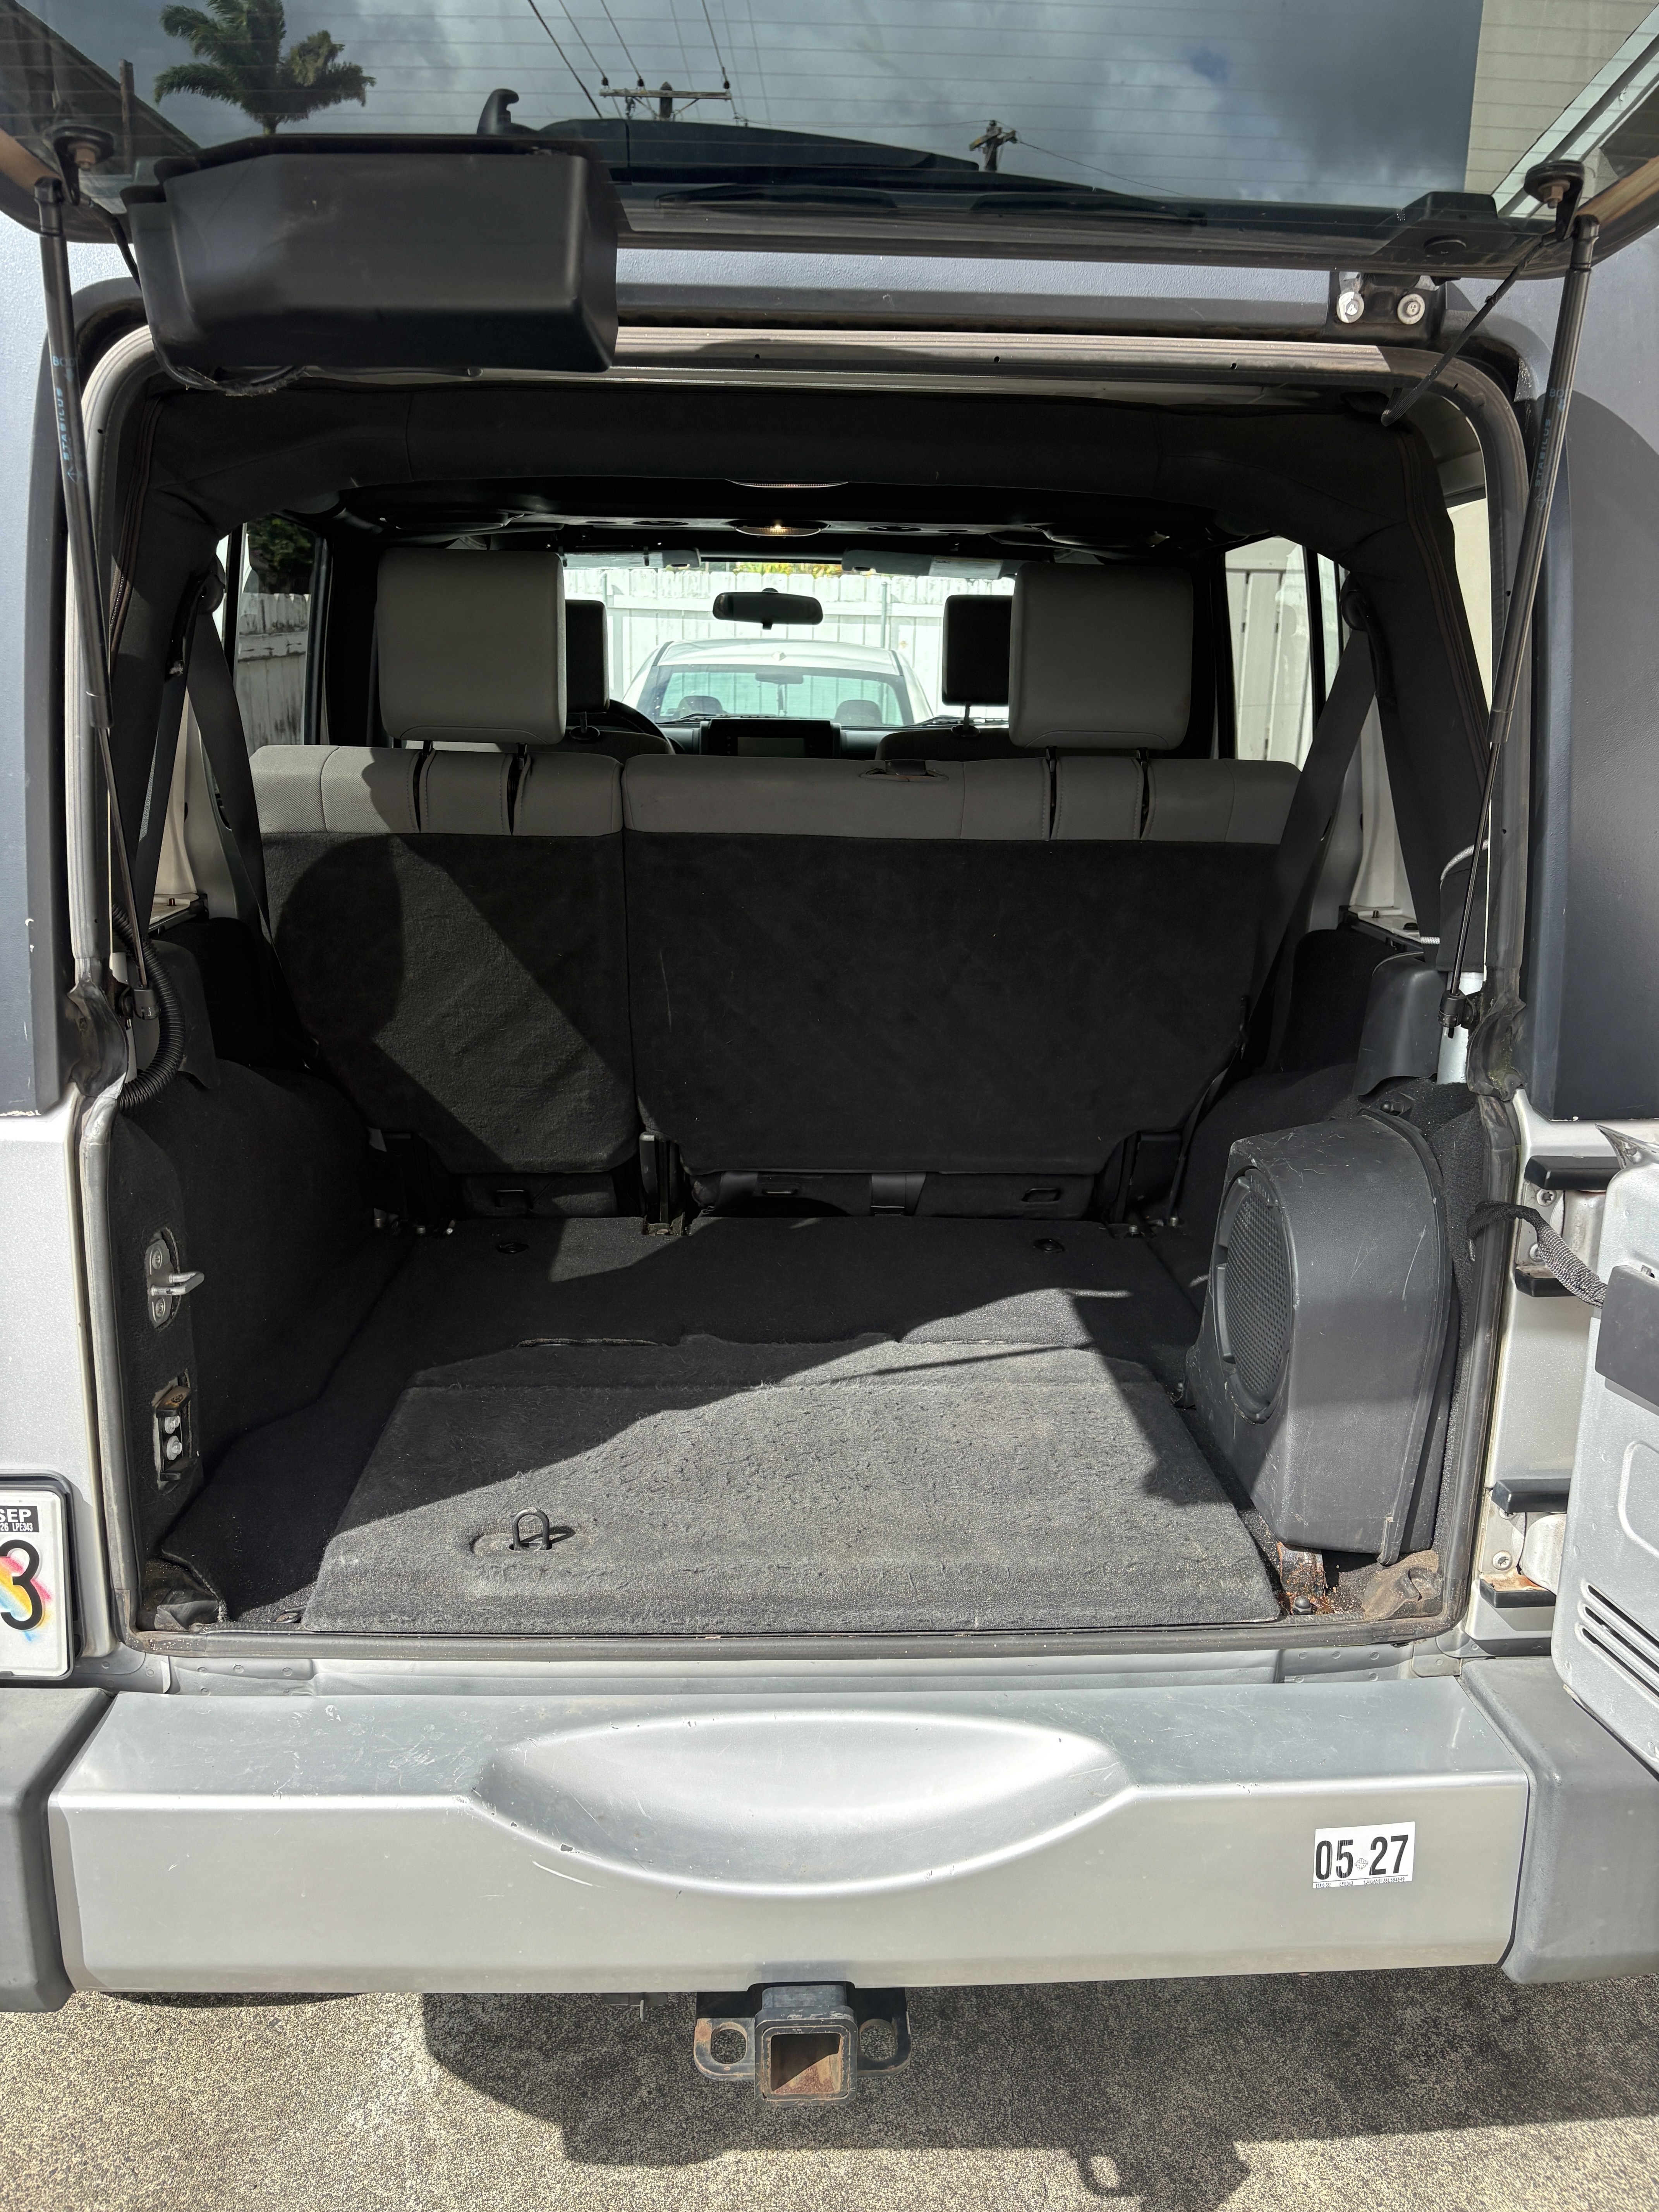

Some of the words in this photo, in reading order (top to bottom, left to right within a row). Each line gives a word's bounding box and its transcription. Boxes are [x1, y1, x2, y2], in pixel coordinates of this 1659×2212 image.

[56, 387, 70, 461] STABILUS
[1534, 418, 1551, 488] STABILUS
[0, 1522, 9, 1531] 26
[12, 1522, 33, 1532] LPE343
[0, 1539, 42, 1630] 3
[1316, 1839, 1353, 1880] 05
[1369, 1834, 1408, 1875] 27
